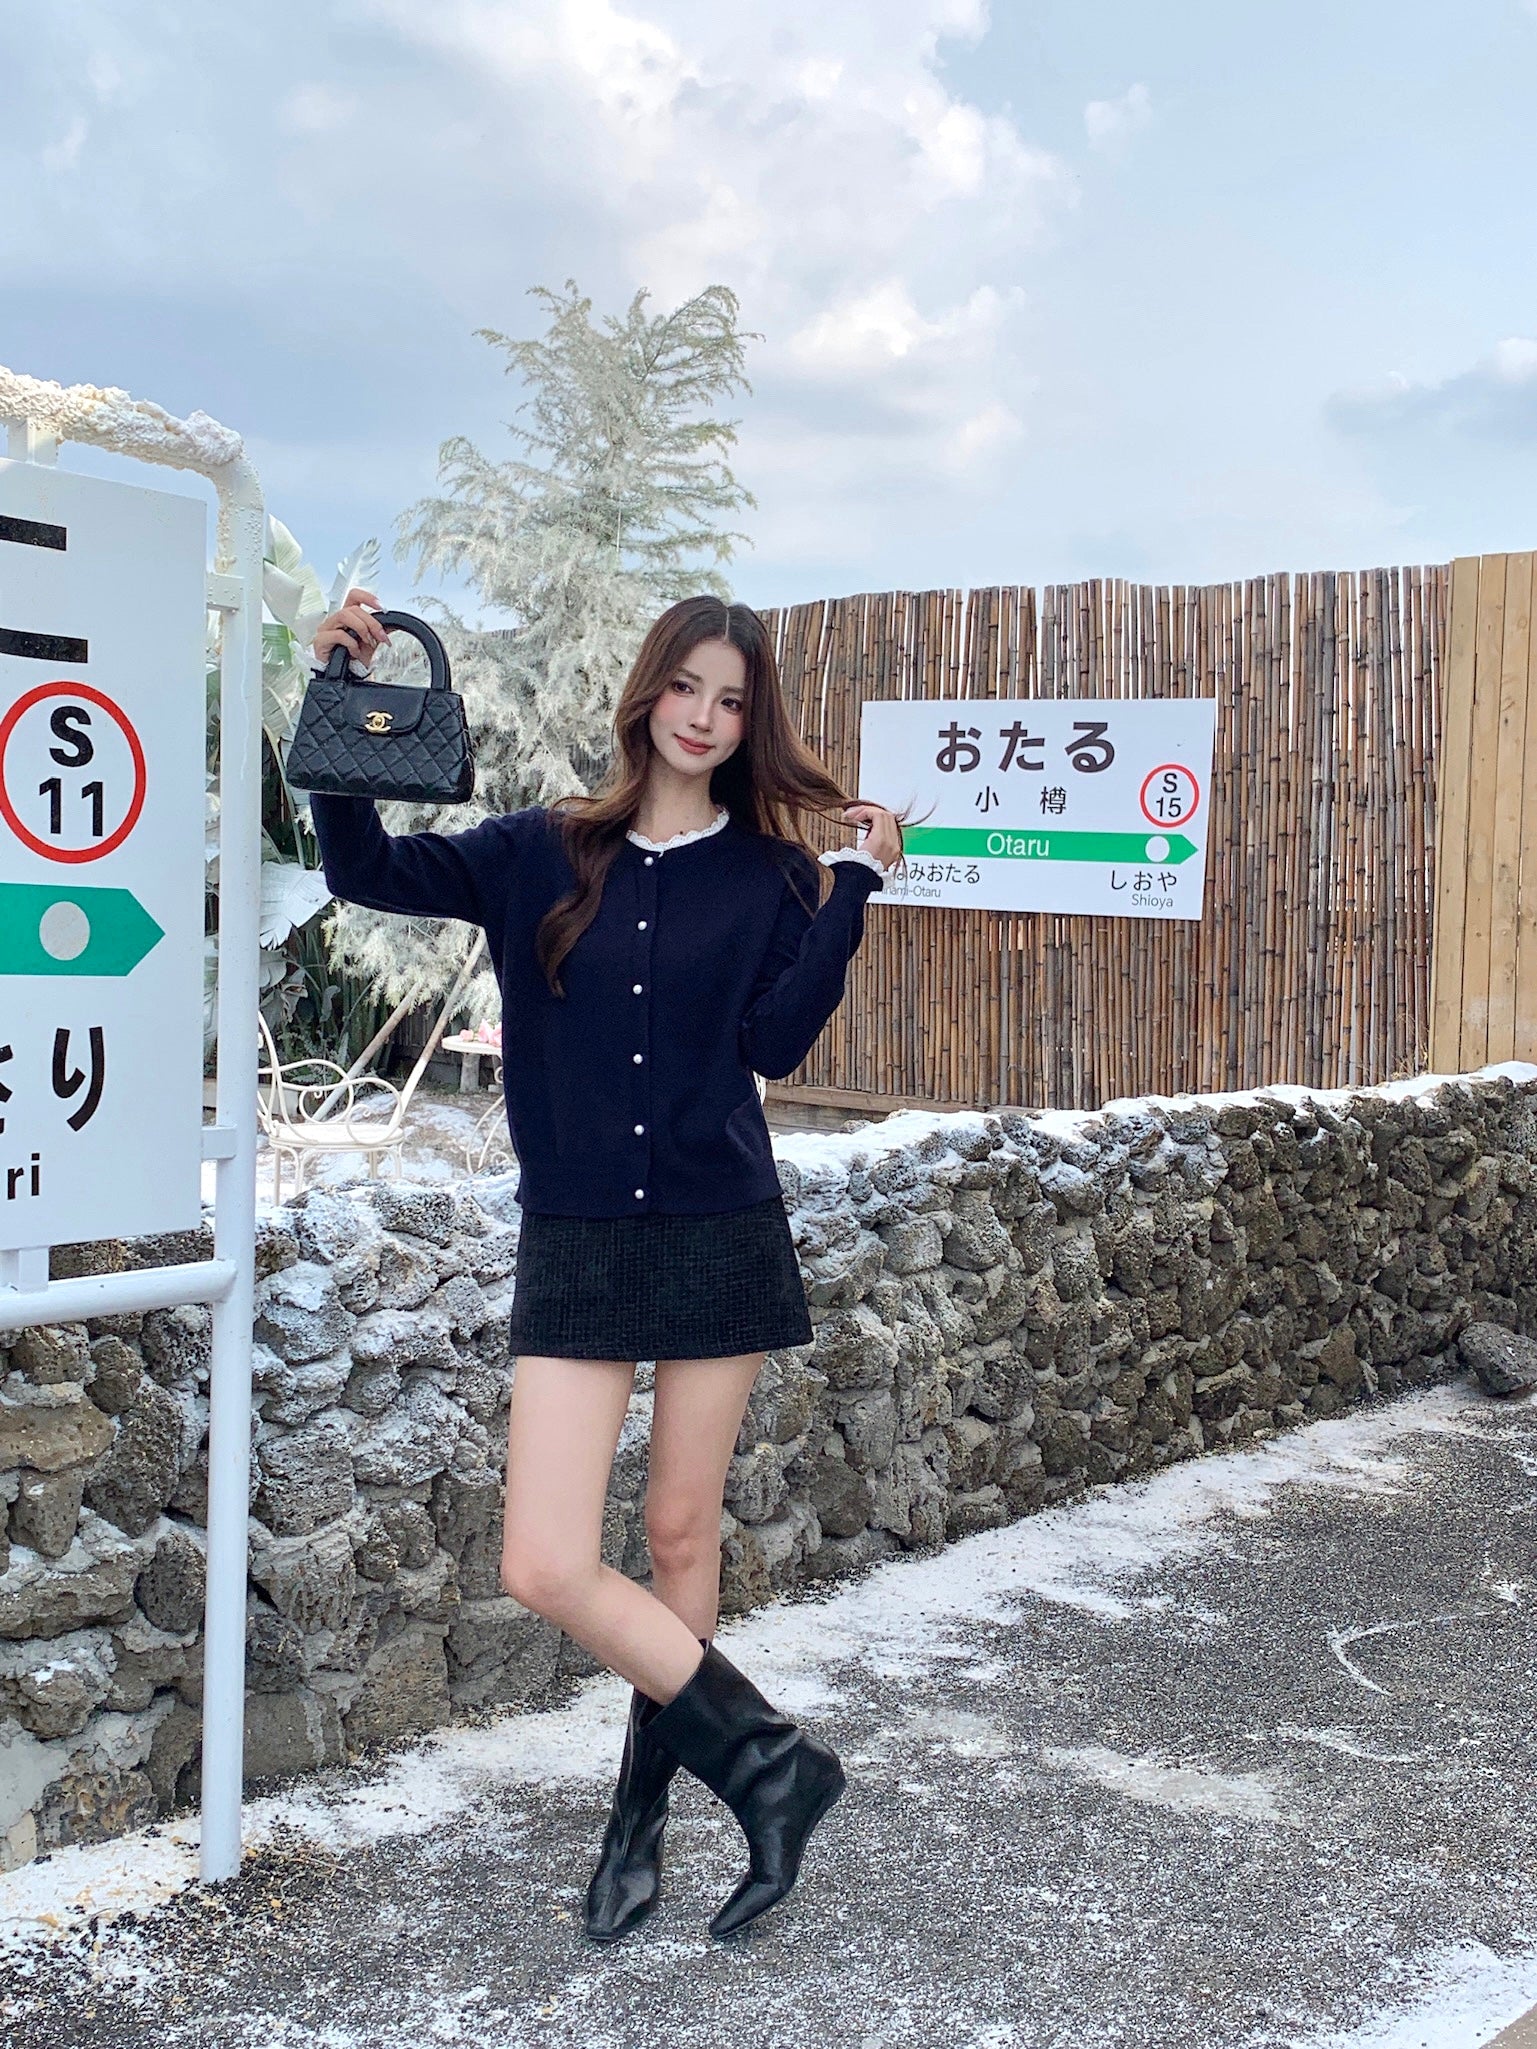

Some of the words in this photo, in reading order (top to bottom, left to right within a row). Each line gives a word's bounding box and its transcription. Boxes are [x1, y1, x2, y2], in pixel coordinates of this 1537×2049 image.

[49, 705, 94, 768] S
[935, 720, 1115, 774] おたる
[1162, 772, 1178, 794] S
[38, 777, 104, 837] 11
[974, 785, 1067, 816] 小樽
[1155, 797, 1182, 818] 15
[986, 832, 1050, 857] Otaru
[875, 884, 942, 899] inami-Otaru
[1110, 869, 1177, 892] しおや
[1131, 893, 1174, 911] Shioya
